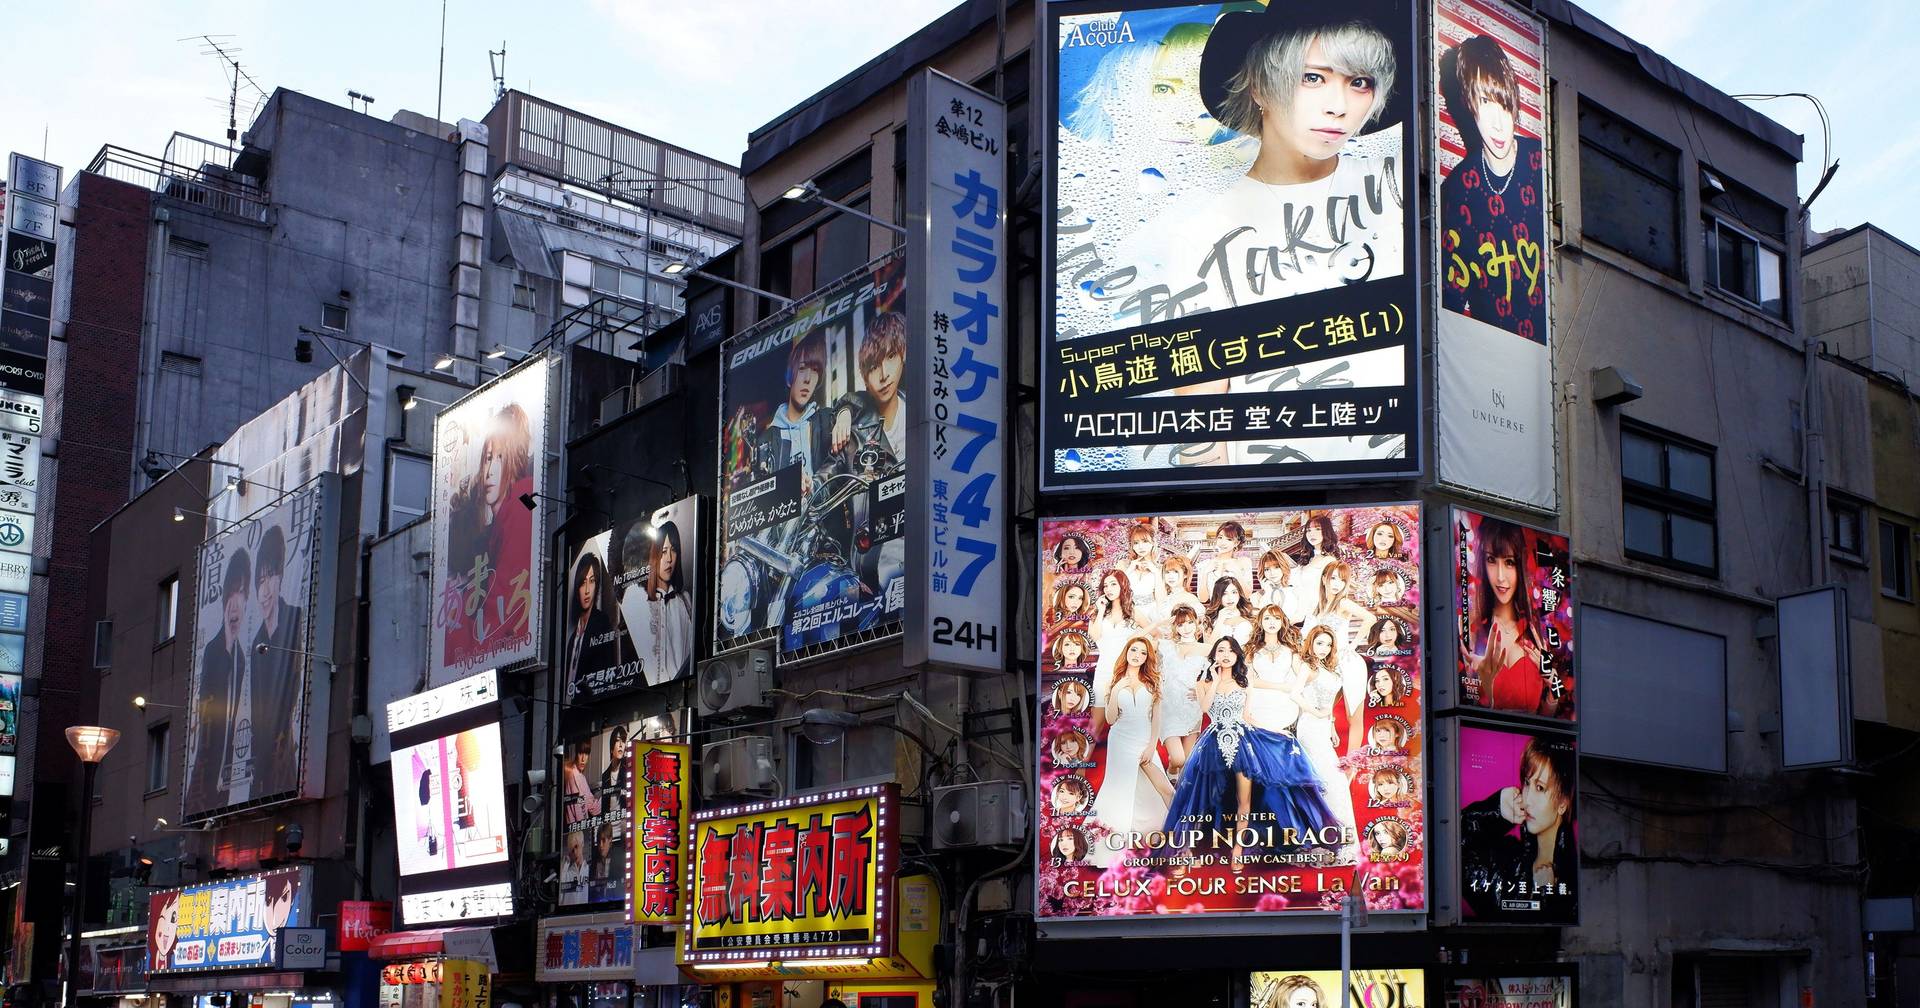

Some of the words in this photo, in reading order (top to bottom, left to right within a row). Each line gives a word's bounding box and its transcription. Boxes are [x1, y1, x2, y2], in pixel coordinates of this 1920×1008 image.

[1069, 21, 1135, 47] ACQUA
[1089, 20, 1116, 31] Club
[26, 180, 46, 195] 8F
[24, 218, 43, 232] 7F
[730, 293, 853, 369] ERUKORACE
[1061, 343, 1126, 364] Super
[1130, 329, 1202, 352] Player
[1059, 354, 1159, 399] 小鳥遊
[29, 418, 40, 433] 5
[1472, 408, 1525, 433] UNIVERSE
[5, 442, 26, 478] マニラ
[15, 478, 36, 487] club
[932, 479, 949, 594] 東宝ビル前
[1537, 551, 1565, 612] 一条響
[437, 552, 532, 644] あまいろ
[791, 595, 883, 635] 第2回エルコレース
[1055, 612, 1062, 622] 3
[933, 616, 998, 653] 24H
[1366, 646, 1375, 657] 6
[1054, 659, 1061, 671] 5
[1051, 676, 1079, 690] CHIHAYA
[1053, 709, 1060, 719] 7
[1366, 747, 1381, 757] 10
[1052, 758, 1060, 769] 9
[1368, 799, 1380, 808] 12
[1180, 814, 1212, 824] 2020
[1222, 812, 1277, 823] WINTER
[642, 748, 681, 917] 無料案内所
[1105, 829, 1204, 851] GROUP
[1212, 827, 1274, 850] NO.1
[1282, 826, 1354, 847] RACE
[697, 802, 873, 930] 無料案内所
[1050, 857, 1061, 868] 13
[1123, 857, 1166, 868] GROUP
[1168, 856, 1199, 867] BEST
[1199, 854, 1214, 867] 10
[1220, 856, 1229, 866] &
[1234, 854, 1261, 865] NEW
[1263, 853, 1294, 864] CAST
[1296, 853, 1325, 864] BEST
[1063, 879, 1151, 898] CELUX
[1167, 877, 1225, 896] FOUR
[1234, 875, 1302, 894] SENSE
[1317, 873, 1344, 893] La
[177, 880, 268, 937] 無料案内所
[285, 944, 323, 955] Colors
[545, 927, 633, 969] 無料案内所
